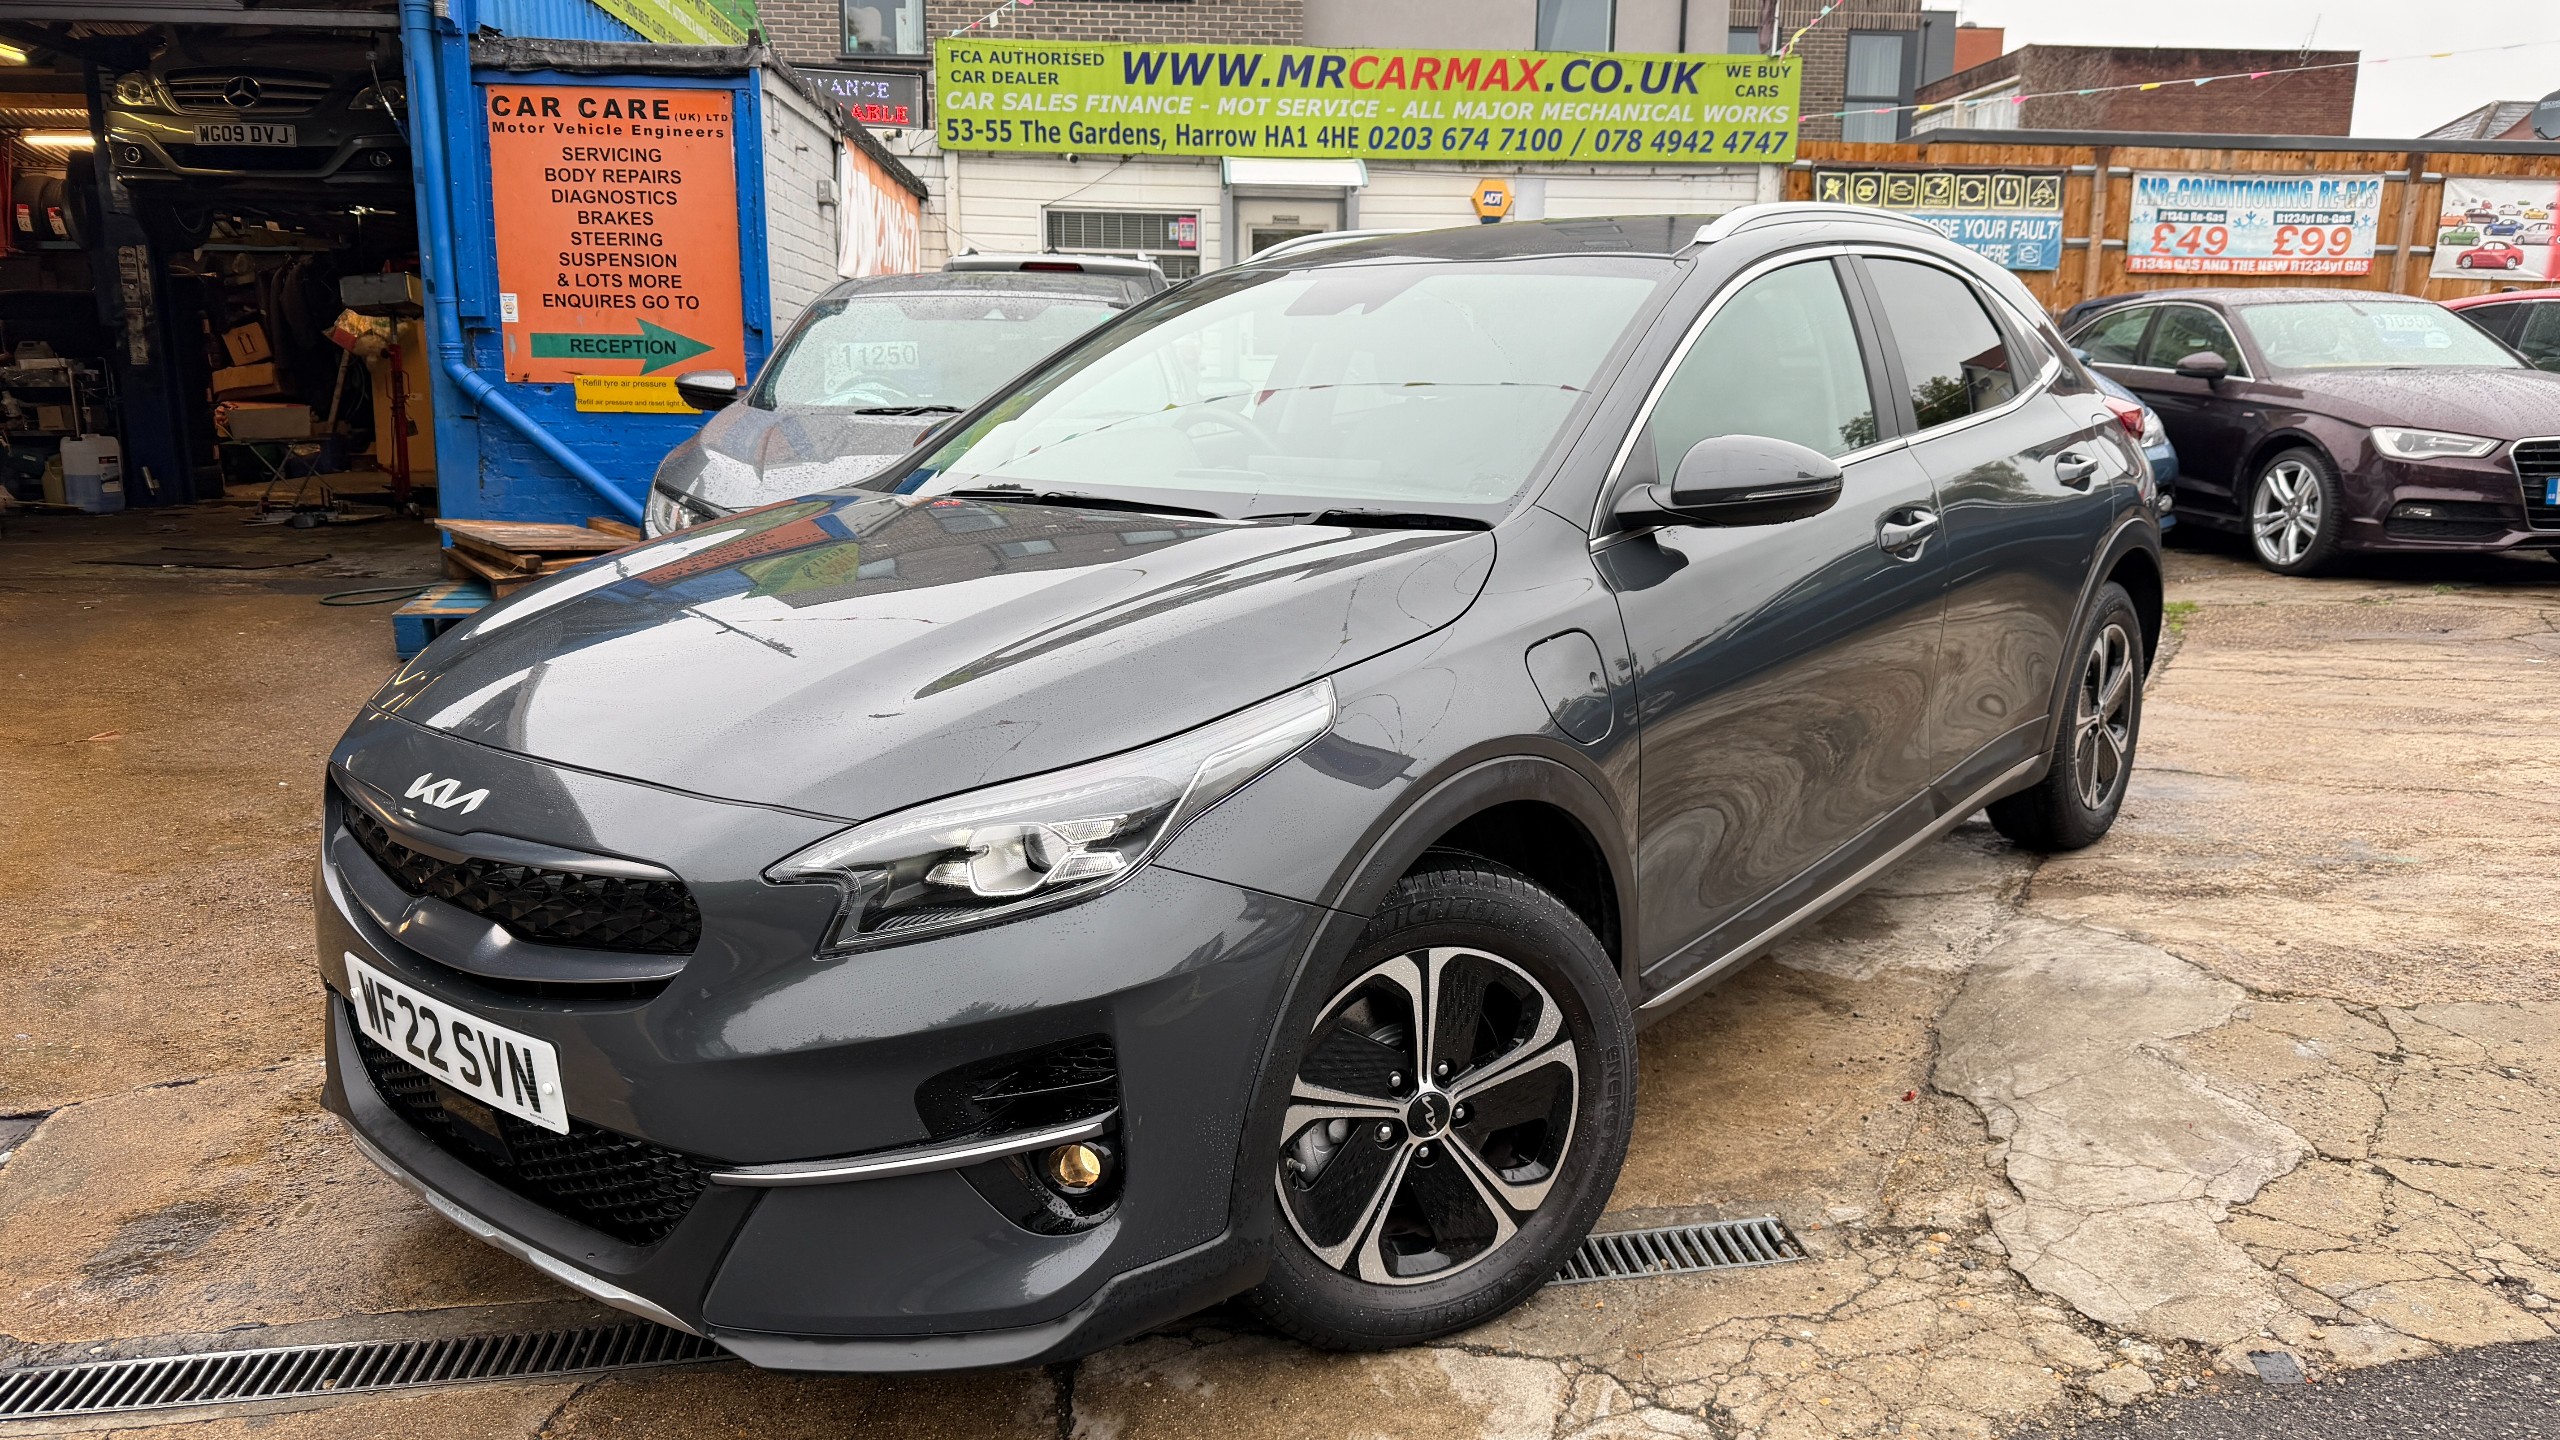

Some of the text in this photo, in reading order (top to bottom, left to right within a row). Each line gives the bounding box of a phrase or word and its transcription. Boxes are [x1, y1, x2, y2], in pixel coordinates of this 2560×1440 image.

[950, 50, 1105, 67] FCA AUTHORISED
[950, 70, 1059, 86] CAR DEALER
[1122, 51, 1706, 95] WWW.MRCARMAX.CO.UK
[1726, 65, 1791, 79] WE BUY
[1735, 84, 1779, 98] CARS
[491, 95, 728, 122] CAR CARE (UK) LTD
[945, 91, 995, 110] CAR
[1001, 93, 1077, 112] SALES
[1085, 95, 1192, 115] FINANCE
[1218, 97, 1271, 116] MOT
[1276, 98, 1378, 118] SERVICE
[1402, 100, 1445, 119] ALL
[1453, 101, 1534, 120] MAJOR
[1540, 103, 1694, 122] MECHANICAL
[1703, 106, 1790, 123] WORKS
[199, 125, 289, 143] WG09 DVJ
[492, 121, 725, 139] Motor Vehicle Engineers
[947, 118, 1012, 142] 53-55
[1020, 120, 1060, 143] The
[1068, 121, 1169, 150] Gardens,
[1175, 123, 1257, 147] Harrow
[1264, 125, 1308, 148] HA1
[1317, 126, 1359, 149] 4HE
[1367, 126, 1432, 150] 0203
[1441, 127, 1489, 151] 674
[1498, 128, 1563, 152] 7100
[1594, 129, 1641, 152] 078
[1650, 130, 1713, 154] 4942
[1722, 131, 1789, 155] 4747
[562, 147, 662, 162] SERVICING
[544, 168, 682, 184] BODY REPAIRS
[551, 189, 678, 205] DIAGNOSTICS
[1483, 192, 1503, 205] ADT
[2136, 178, 2379, 209] AIR-CONDITIONING RE-GAS
[577, 211, 654, 225] BRAKES
[1964, 219, 2006, 239] YOUR
[2009, 221, 2058, 240] FAULT
[570, 232, 663, 247] STEERING
[2150, 223, 2229, 256] £49
[2272, 225, 2353, 257] £99
[559, 252, 677, 268] SUSPENSION
[2173, 258, 2200, 271] GAS
[2201, 260, 2229, 271] AND
[2231, 260, 2256, 271] THE
[2257, 260, 2289, 271] NEW
[2344, 261, 2369, 272] GAS
[557, 274, 682, 289] & LOTS MORE
[543, 294, 699, 310] ENQUIRES GO TO
[570, 338, 677, 355] RECEPTION
[582, 379, 602, 387] Refill
[603, 380, 619, 390] tyre
[357, 969, 542, 1115] WF22 SVN
